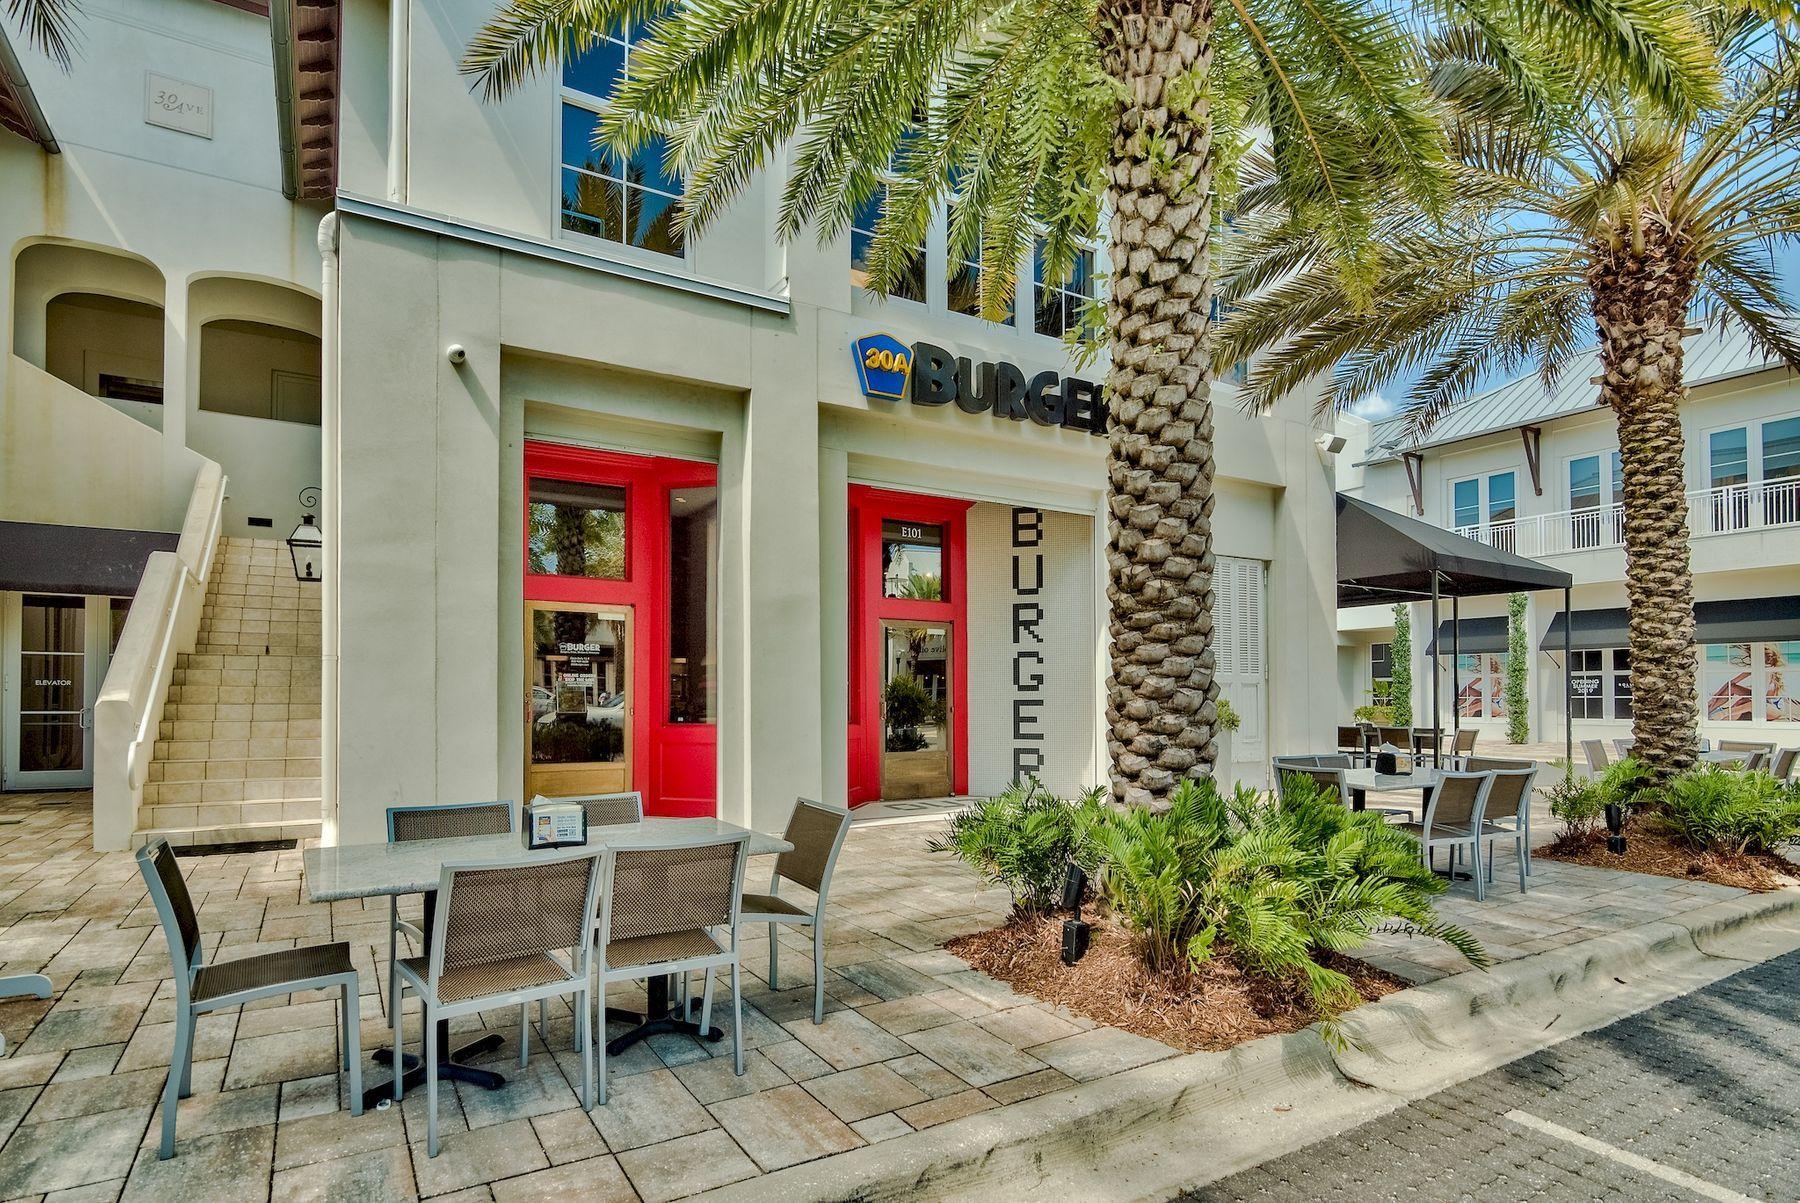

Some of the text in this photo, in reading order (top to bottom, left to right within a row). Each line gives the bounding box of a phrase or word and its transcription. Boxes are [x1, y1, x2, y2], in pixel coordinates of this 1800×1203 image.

[865, 347, 911, 376] 30A
[901, 526, 922, 539] E101
[567, 643, 600, 651] BURGER
[1012, 507, 1044, 789] BURGER
